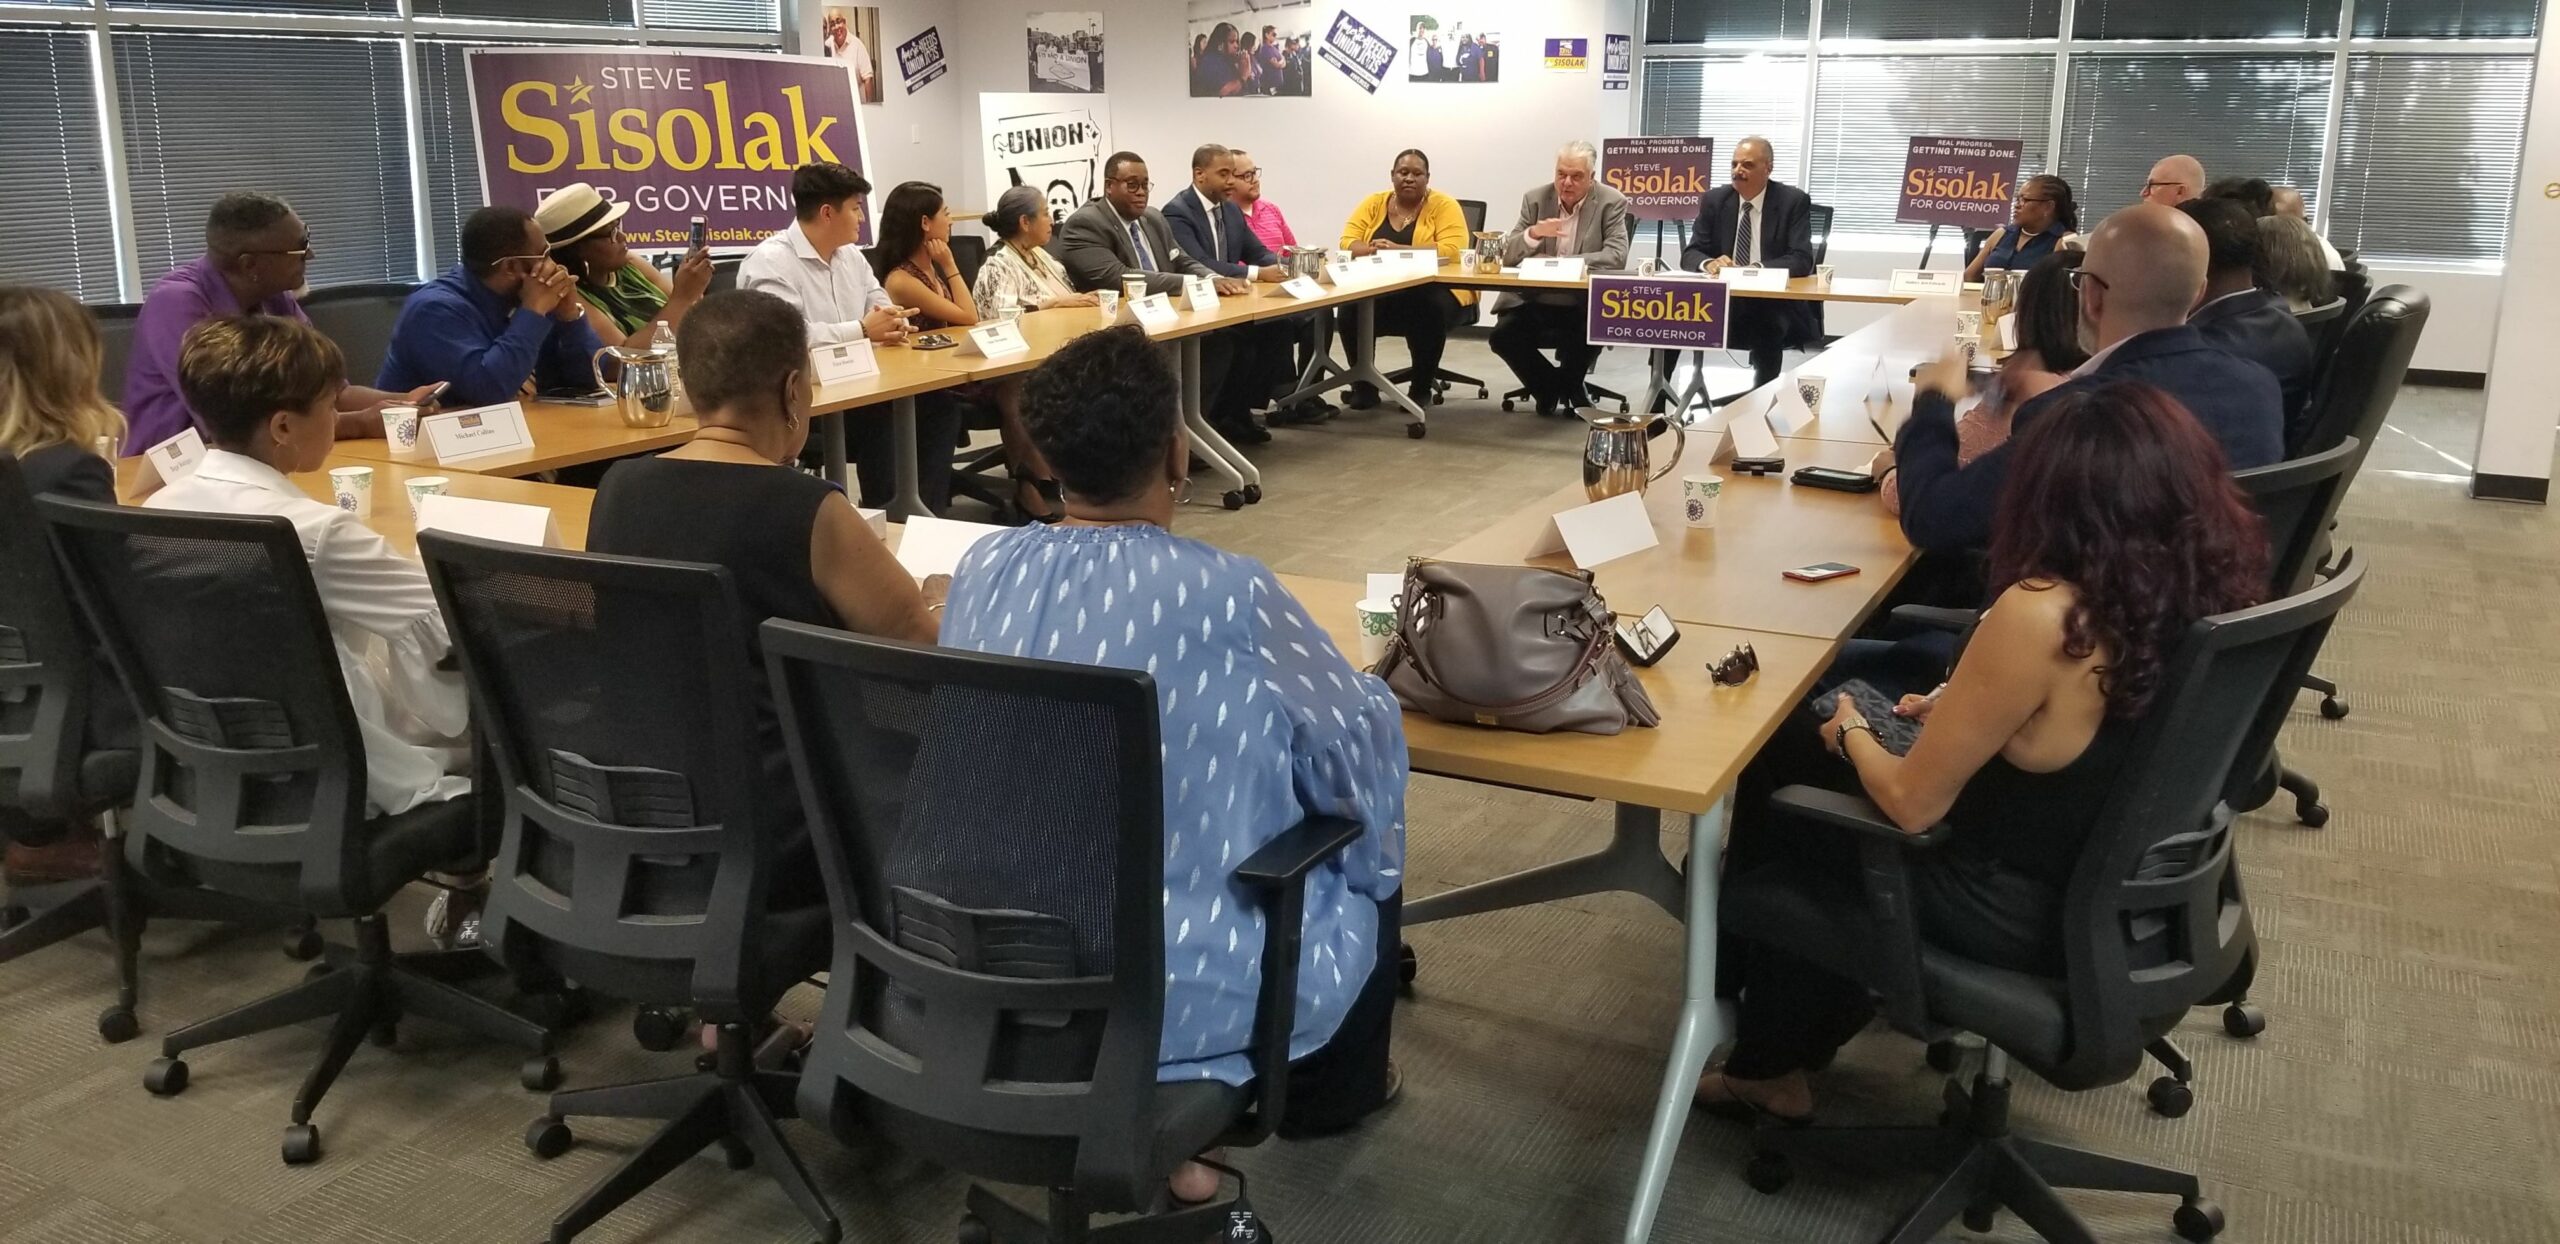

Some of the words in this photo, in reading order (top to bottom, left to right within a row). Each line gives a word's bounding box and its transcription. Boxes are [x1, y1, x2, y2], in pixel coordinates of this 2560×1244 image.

[1332, 30, 1362, 59] UNION
[1554, 58, 1585, 67] SISOLAK
[601, 67, 694, 91] STEVE
[501, 75, 842, 174] Sisolak
[1007, 122, 1084, 154] UNION
[1606, 146, 1644, 155] GETTING
[1647, 145, 1680, 154] THINGS
[1682, 145, 1710, 153] DONE.
[1912, 146, 1951, 155] GETTING
[1953, 147, 1986, 157] THINGS
[1989, 149, 2018, 158] DONE.
[1634, 163, 1661, 172] STEVE
[1937, 165, 1966, 174] STEVE
[1606, 166, 1706, 194] Sisolak
[1906, 168, 2011, 201] Sisolak
[536, 186, 617, 210] FR
[635, 185, 796, 212] GOVERN
[1636, 196, 1699, 206] GOVERNOR
[1909, 198, 1933, 209] FOR
[1935, 200, 2000, 213] GOVERNOR
[1632, 286, 1662, 295] STEVE
[1601, 289, 1714, 322] Sisolak
[1607, 326, 1632, 337] FOR
[1635, 328, 1706, 341] GOVERNOR
